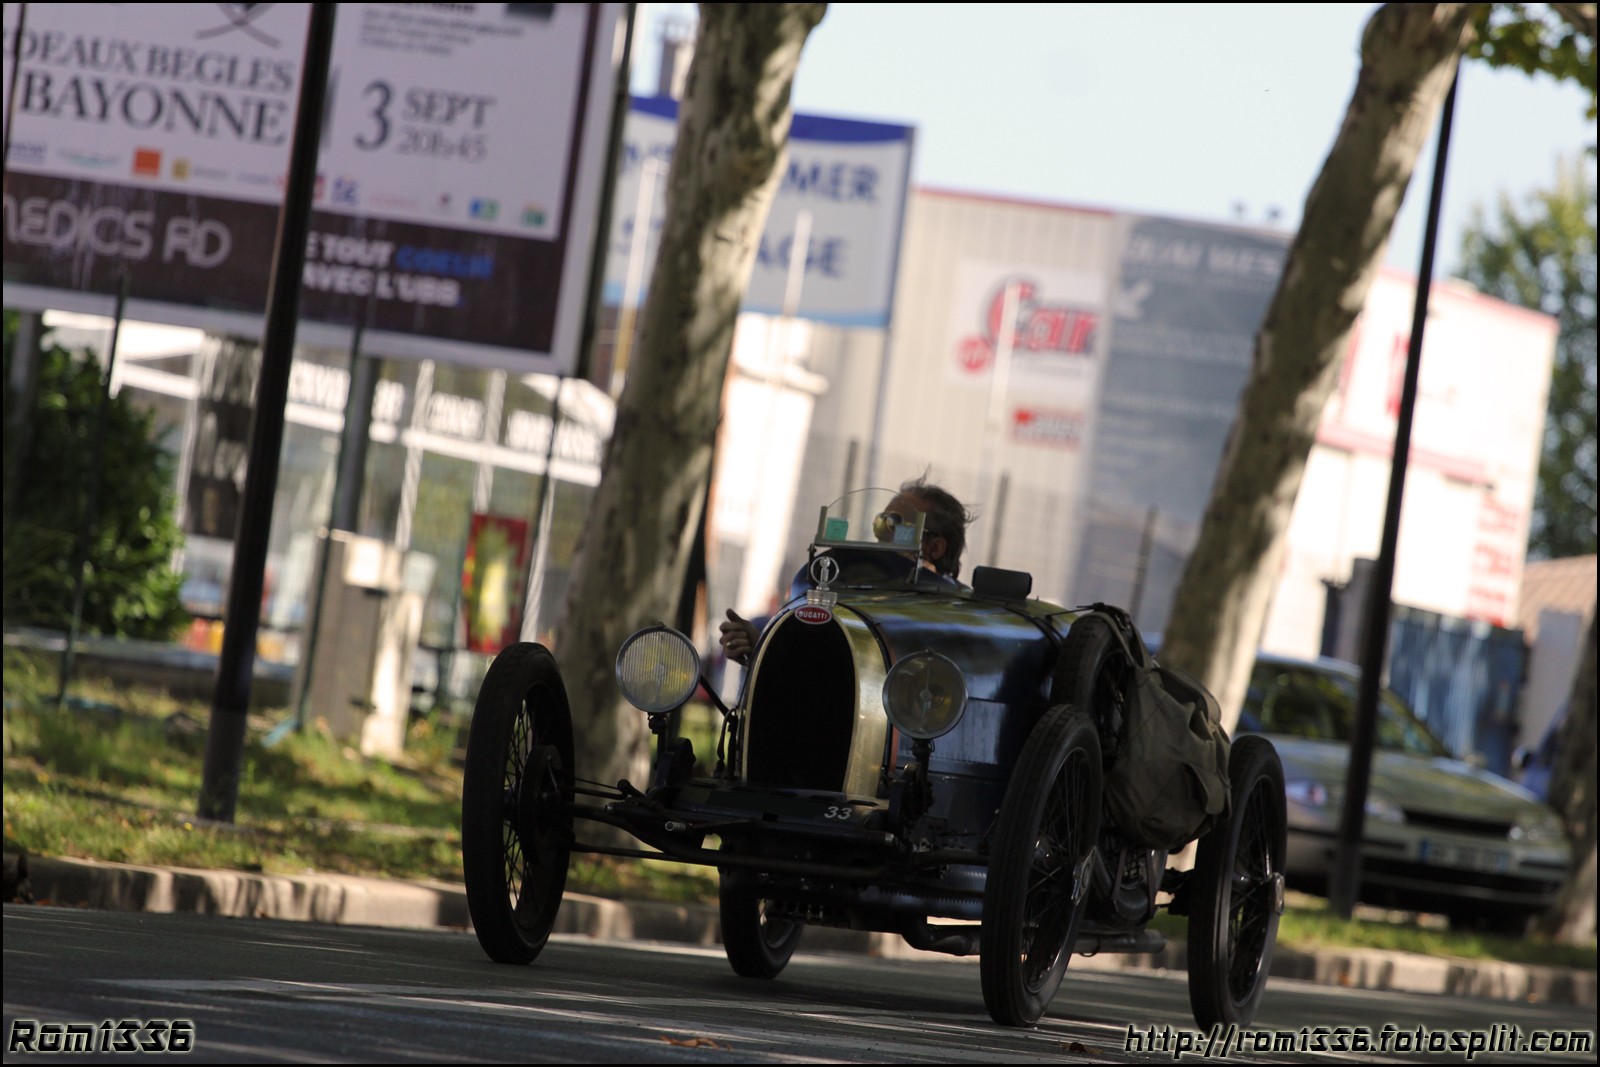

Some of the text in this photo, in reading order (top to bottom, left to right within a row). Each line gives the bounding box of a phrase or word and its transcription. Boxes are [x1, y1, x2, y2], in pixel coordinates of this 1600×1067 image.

[3, 27, 296, 94] DEAUX BEGLES
[19, 68, 289, 146] BAYONNE
[354, 78, 396, 150] 3
[401, 86, 499, 130] SEPT
[321, 233, 396, 269] TOUT
[303, 262, 375, 297] AVEC
[798, 610, 828, 620] BUGATTI
[824, 806, 853, 820] 33
